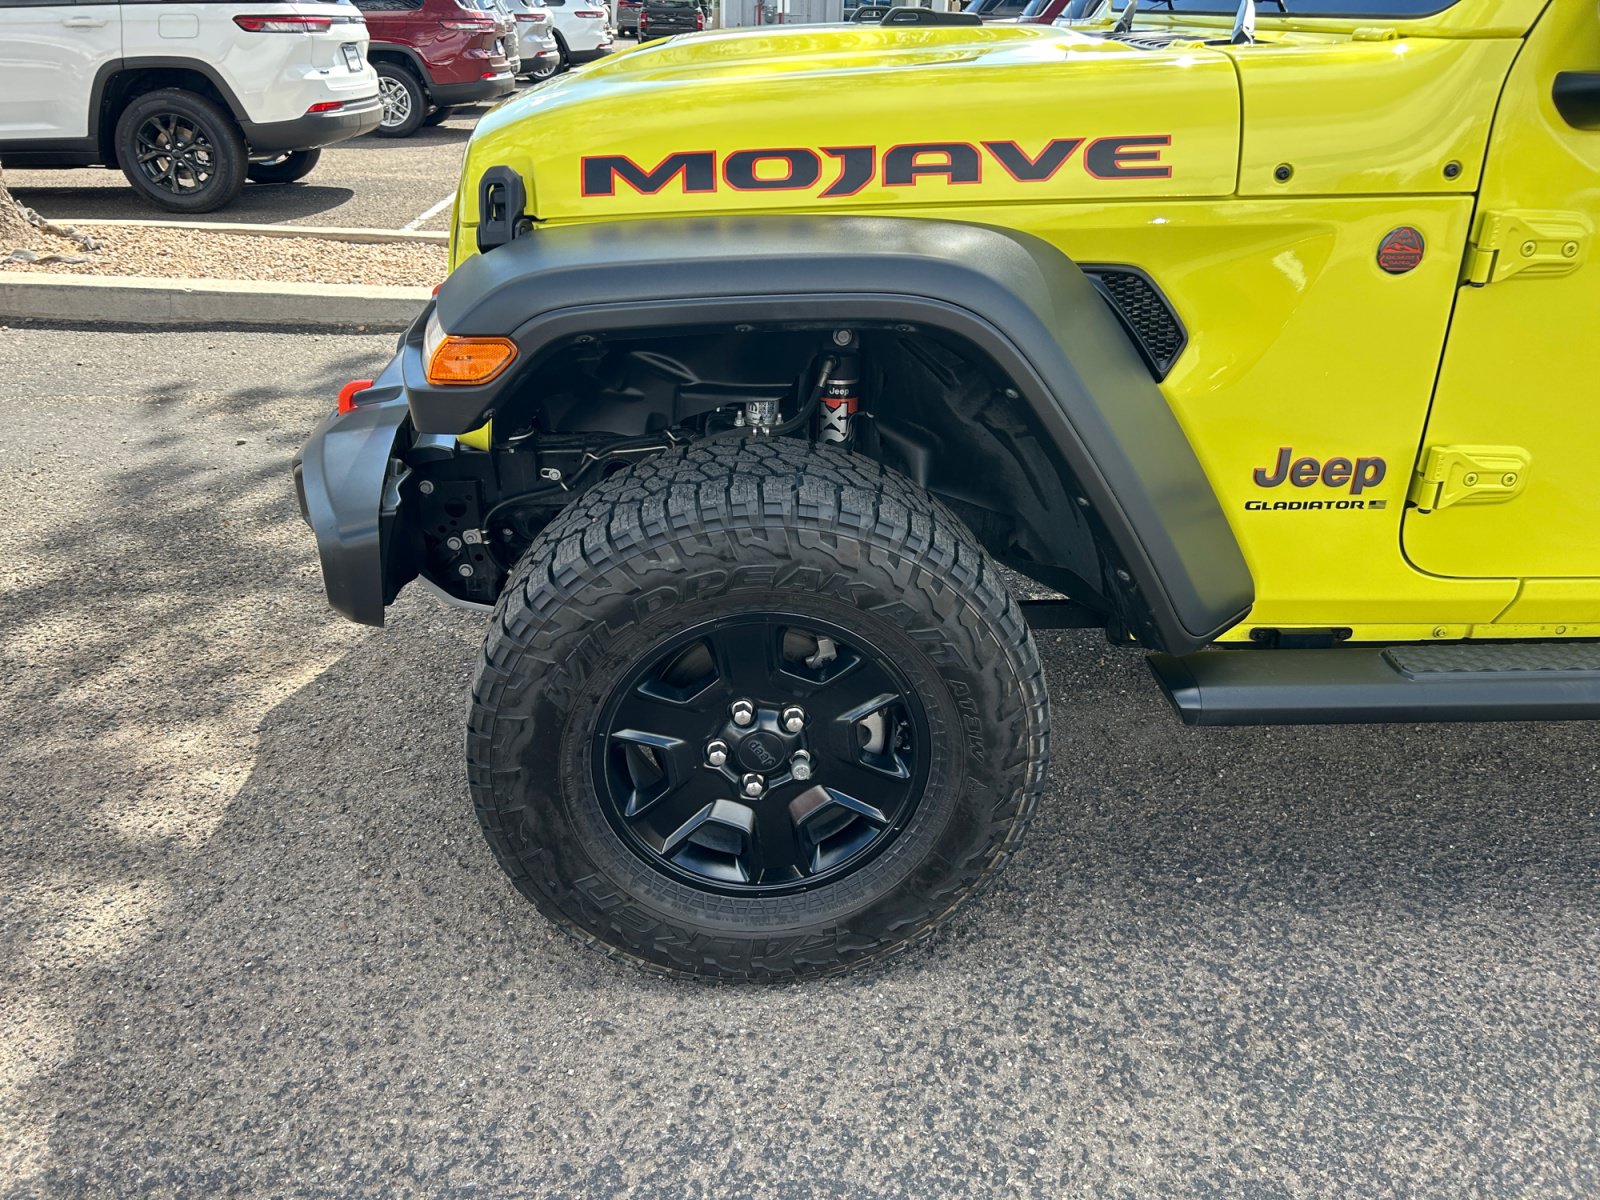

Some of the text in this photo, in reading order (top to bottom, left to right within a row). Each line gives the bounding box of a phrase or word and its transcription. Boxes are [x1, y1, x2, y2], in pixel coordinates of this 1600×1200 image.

[581, 135, 1172, 198] MOJAVE
[829, 387, 850, 397] Jeep
[1253, 446, 1387, 495] Jeep
[1244, 500, 1364, 511] GLADIATOR
[544, 564, 877, 710] WILDPEAK
[748, 740, 776, 765] Jeep
[574, 872, 837, 957] FALKEN
